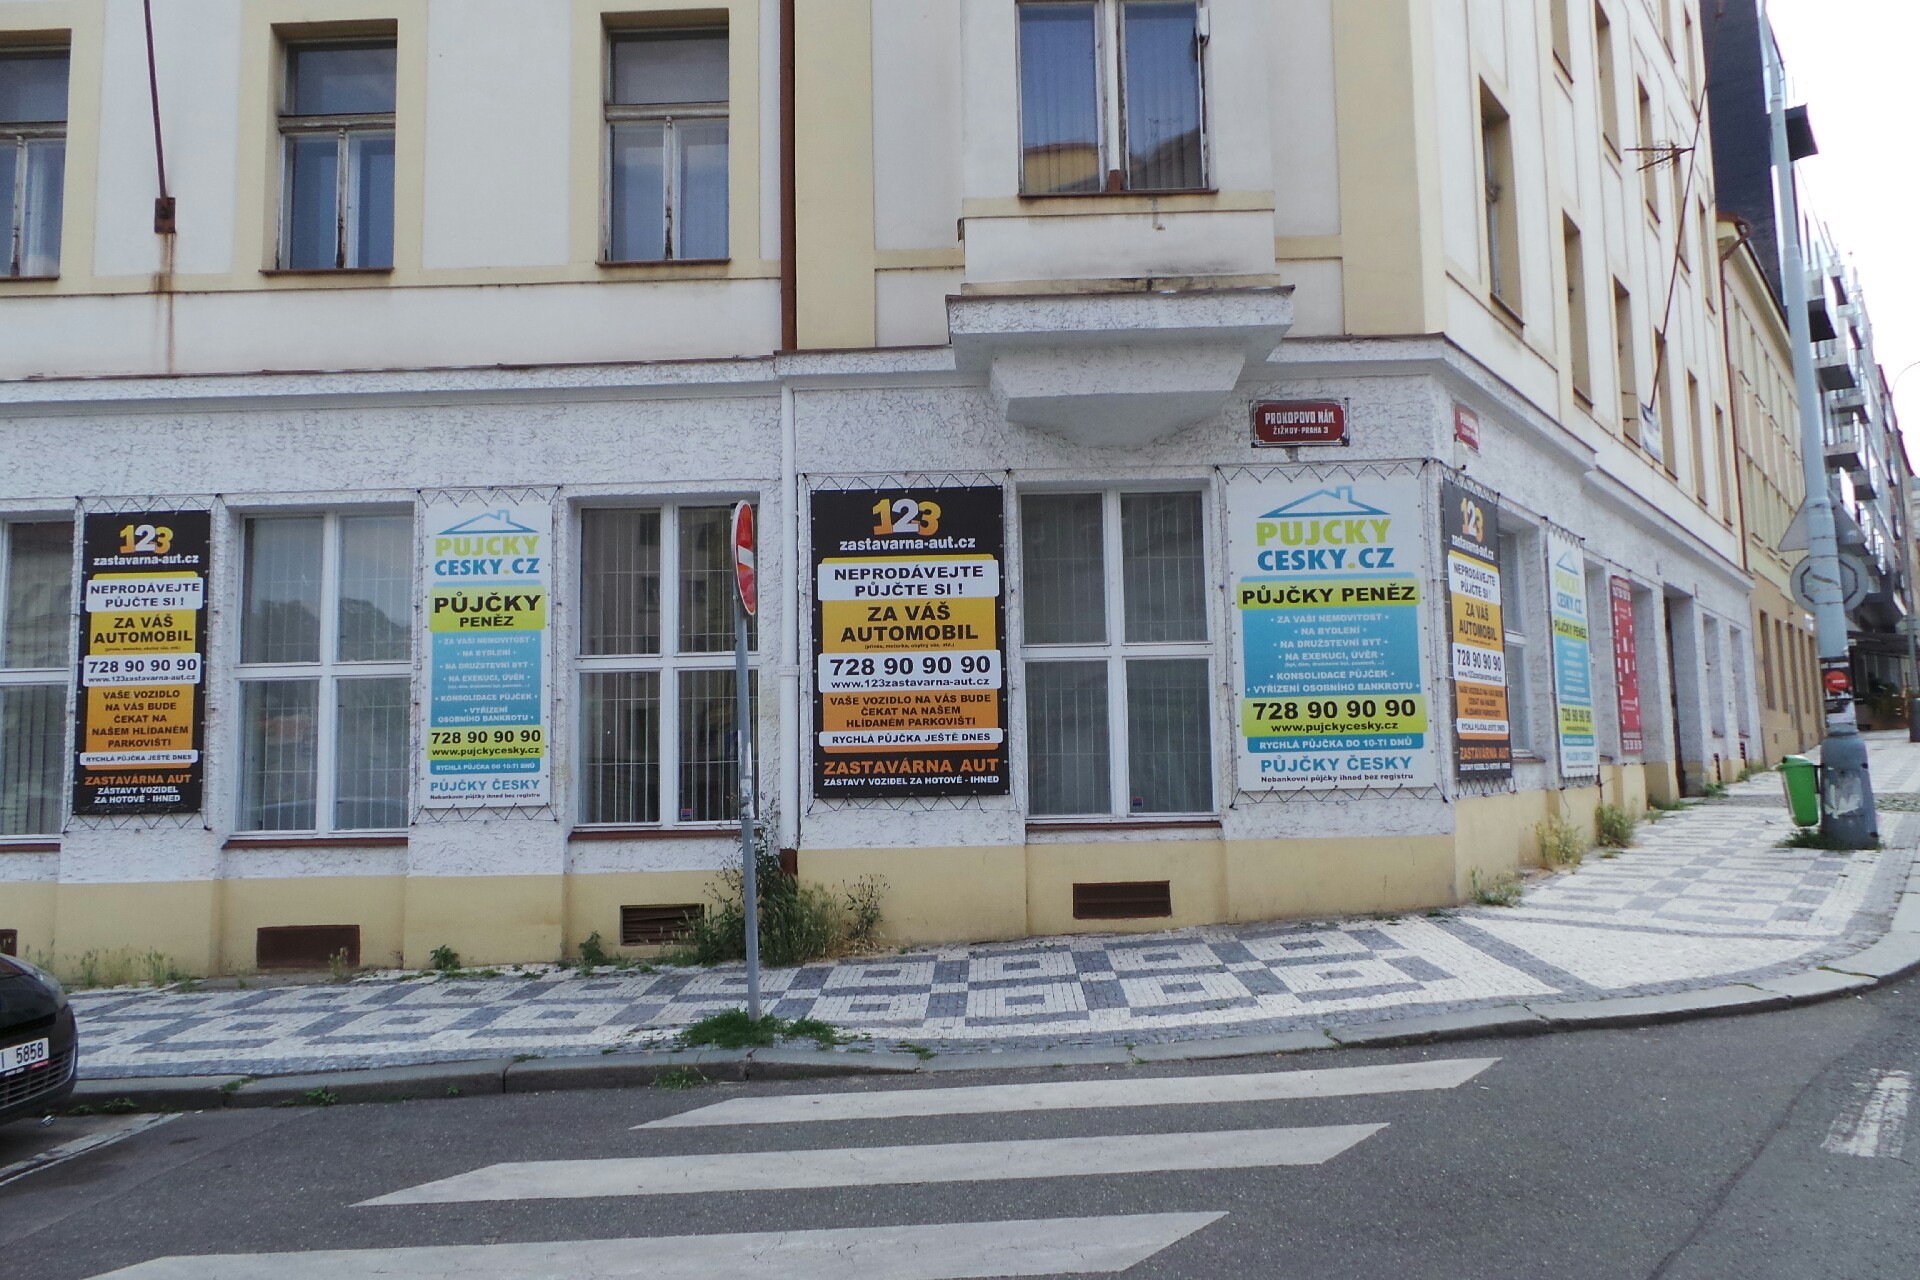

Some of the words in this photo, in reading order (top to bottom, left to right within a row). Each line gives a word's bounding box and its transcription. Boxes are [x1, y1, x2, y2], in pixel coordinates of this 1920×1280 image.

[1265, 411, 1315, 424] PROKOPOVO
[872, 498, 941, 536] 123
[1461, 498, 1483, 542] 123
[120, 524, 173, 554] 123
[1256, 519, 1392, 547] PUJCKY
[435, 536, 539, 557] PUJCKY
[840, 536, 976, 551] zastavarna-aut.cz
[93, 554, 199, 566] zastavarna-aut.cz
[1258, 548, 1394, 571] CESKY.CZ
[435, 558, 540, 576] CESKY.CZ
[834, 565, 983, 580] NEPRODÁVEJTE
[91, 582, 200, 594] NEPRODÁVEJTE
[855, 582, 928, 597] PŮJČTE
[935, 584, 950, 595] SI
[1243, 585, 1333, 604] PŮJČKY
[1342, 583, 1415, 602] PENĚZ
[163, 598, 175, 606] SI
[434, 592, 541, 613] PŮJČKY
[868, 606, 898, 621] ZA
[905, 602, 950, 620] VÁŠ
[1293, 614, 1316, 623] VAŠI
[1319, 613, 1382, 622] NEMOVITOST
[1466, 602, 1475, 616] ZA
[1477, 602, 1489, 621] VÁŠ
[114, 618, 135, 628] ZA
[141, 613, 173, 628] VÁŠ
[460, 614, 514, 627] PENĚZ
[841, 624, 978, 642] AUTOMOBIL
[1318, 626, 1360, 635] BYDLENÍ
[1459, 619, 1497, 640] AUTOMOBIL
[94, 630, 192, 644] AUTOMOBIL
[1280, 640, 1294, 648] NA
[1298, 638, 1359, 648] DRUŽSTEVNÍ
[1285, 653, 1299, 661] NA
[1303, 652, 1348, 661] EXEKUCI,
[1352, 650, 1378, 659] ÚVĚR
[1457, 649, 1470, 666] 728
[1473, 652, 1481, 668] 90
[1483, 654, 1491, 670] 90
[1493, 656, 1501, 671] 90
[89, 661, 119, 673] 728
[125, 660, 144, 672] 90
[151, 660, 170, 671] 90
[177, 659, 197, 671] 90
[830, 658, 875, 676] 728
[884, 658, 913, 675] 90
[922, 657, 952, 674] 90
[960, 656, 990, 673] 90
[88, 674, 196, 682] www.123zastavarna-aut.cz
[1277, 671, 1346, 680] KONSOLIDACE
[1350, 669, 1388, 678] PŮJČEK
[831, 677, 990, 689] www.123zastavarna-aut.cz
[1254, 684, 1299, 693] VYŘÍZENÍ
[1303, 683, 1355, 692] OSOBNÍHO
[103, 690, 130, 699] VAŠE
[134, 690, 180, 698] VOZIDLO
[441, 694, 496, 702] KONSOLIDACE
[830, 694, 859, 705] VAŠE
[863, 696, 911, 704] VOZIDLO
[916, 696, 931, 704] NA
[935, 694, 956, 703] VÁS
[961, 694, 991, 702] BUDE
[124, 702, 144, 710] VÁS
[148, 702, 176, 710] BUDE
[861, 706, 898, 716] ČEKAT
[902, 707, 917, 715] NA
[922, 706, 961, 714] NAŠEM
[1253, 702, 1298, 720] 728
[1308, 701, 1337, 719] 90
[1347, 700, 1376, 717] 90
[1385, 699, 1415, 716] 90
[483, 714, 528, 722] BANKROTU
[847, 718, 904, 727] HLÍDANÉM
[908, 716, 975, 726] PARKOVIŠTI
[92, 727, 129, 735] NAŠEM
[133, 726, 188, 734] HLÍDANÉM
[1271, 721, 1398, 733] www.pujckycesky.cz
[108, 738, 171, 747] PARKOVIŠTI
[432, 732, 461, 744] 728
[468, 731, 487, 743] 90
[494, 731, 514, 743] 90
[521, 730, 541, 742] 90
[832, 734, 873, 744] RYCHLÁ
[878, 733, 921, 743] PŮJČKA
[925, 732, 958, 742] JEŠTĚ
[962, 733, 990, 741] DNES
[1260, 740, 1299, 749] RYCHLÁ
[1303, 738, 1343, 748] PŮJČKA
[1346, 739, 1360, 747] DO
[1363, 738, 1387, 746] 10-TI
[1390, 736, 1412, 746] DNŮ
[432, 746, 539, 757] www.pujckycesky.cz
[824, 758, 953, 775] ZASTAVÁRNA
[960, 758, 999, 772] AUT
[1261, 755, 1339, 772] PŮJČKY
[1347, 755, 1412, 771] ČESKY
[85, 774, 163, 785] ZASTAVÁRNA
[167, 774, 191, 783] AUT
[431, 779, 487, 791] PŮJČKY
[492, 778, 540, 790] ČESKY
[824, 776, 864, 786] ZÁSTAVY
[868, 777, 907, 785] VOZIDEL
[925, 774, 962, 784] HOTOVÉ
[971, 776, 999, 784] IHNED
[1311, 773, 1337, 783] půjčky
[1340, 773, 1362, 781] ihned
[98, 786, 138, 794] ZÁSTAVY
[16, 1042, 43, 1063] 5858
